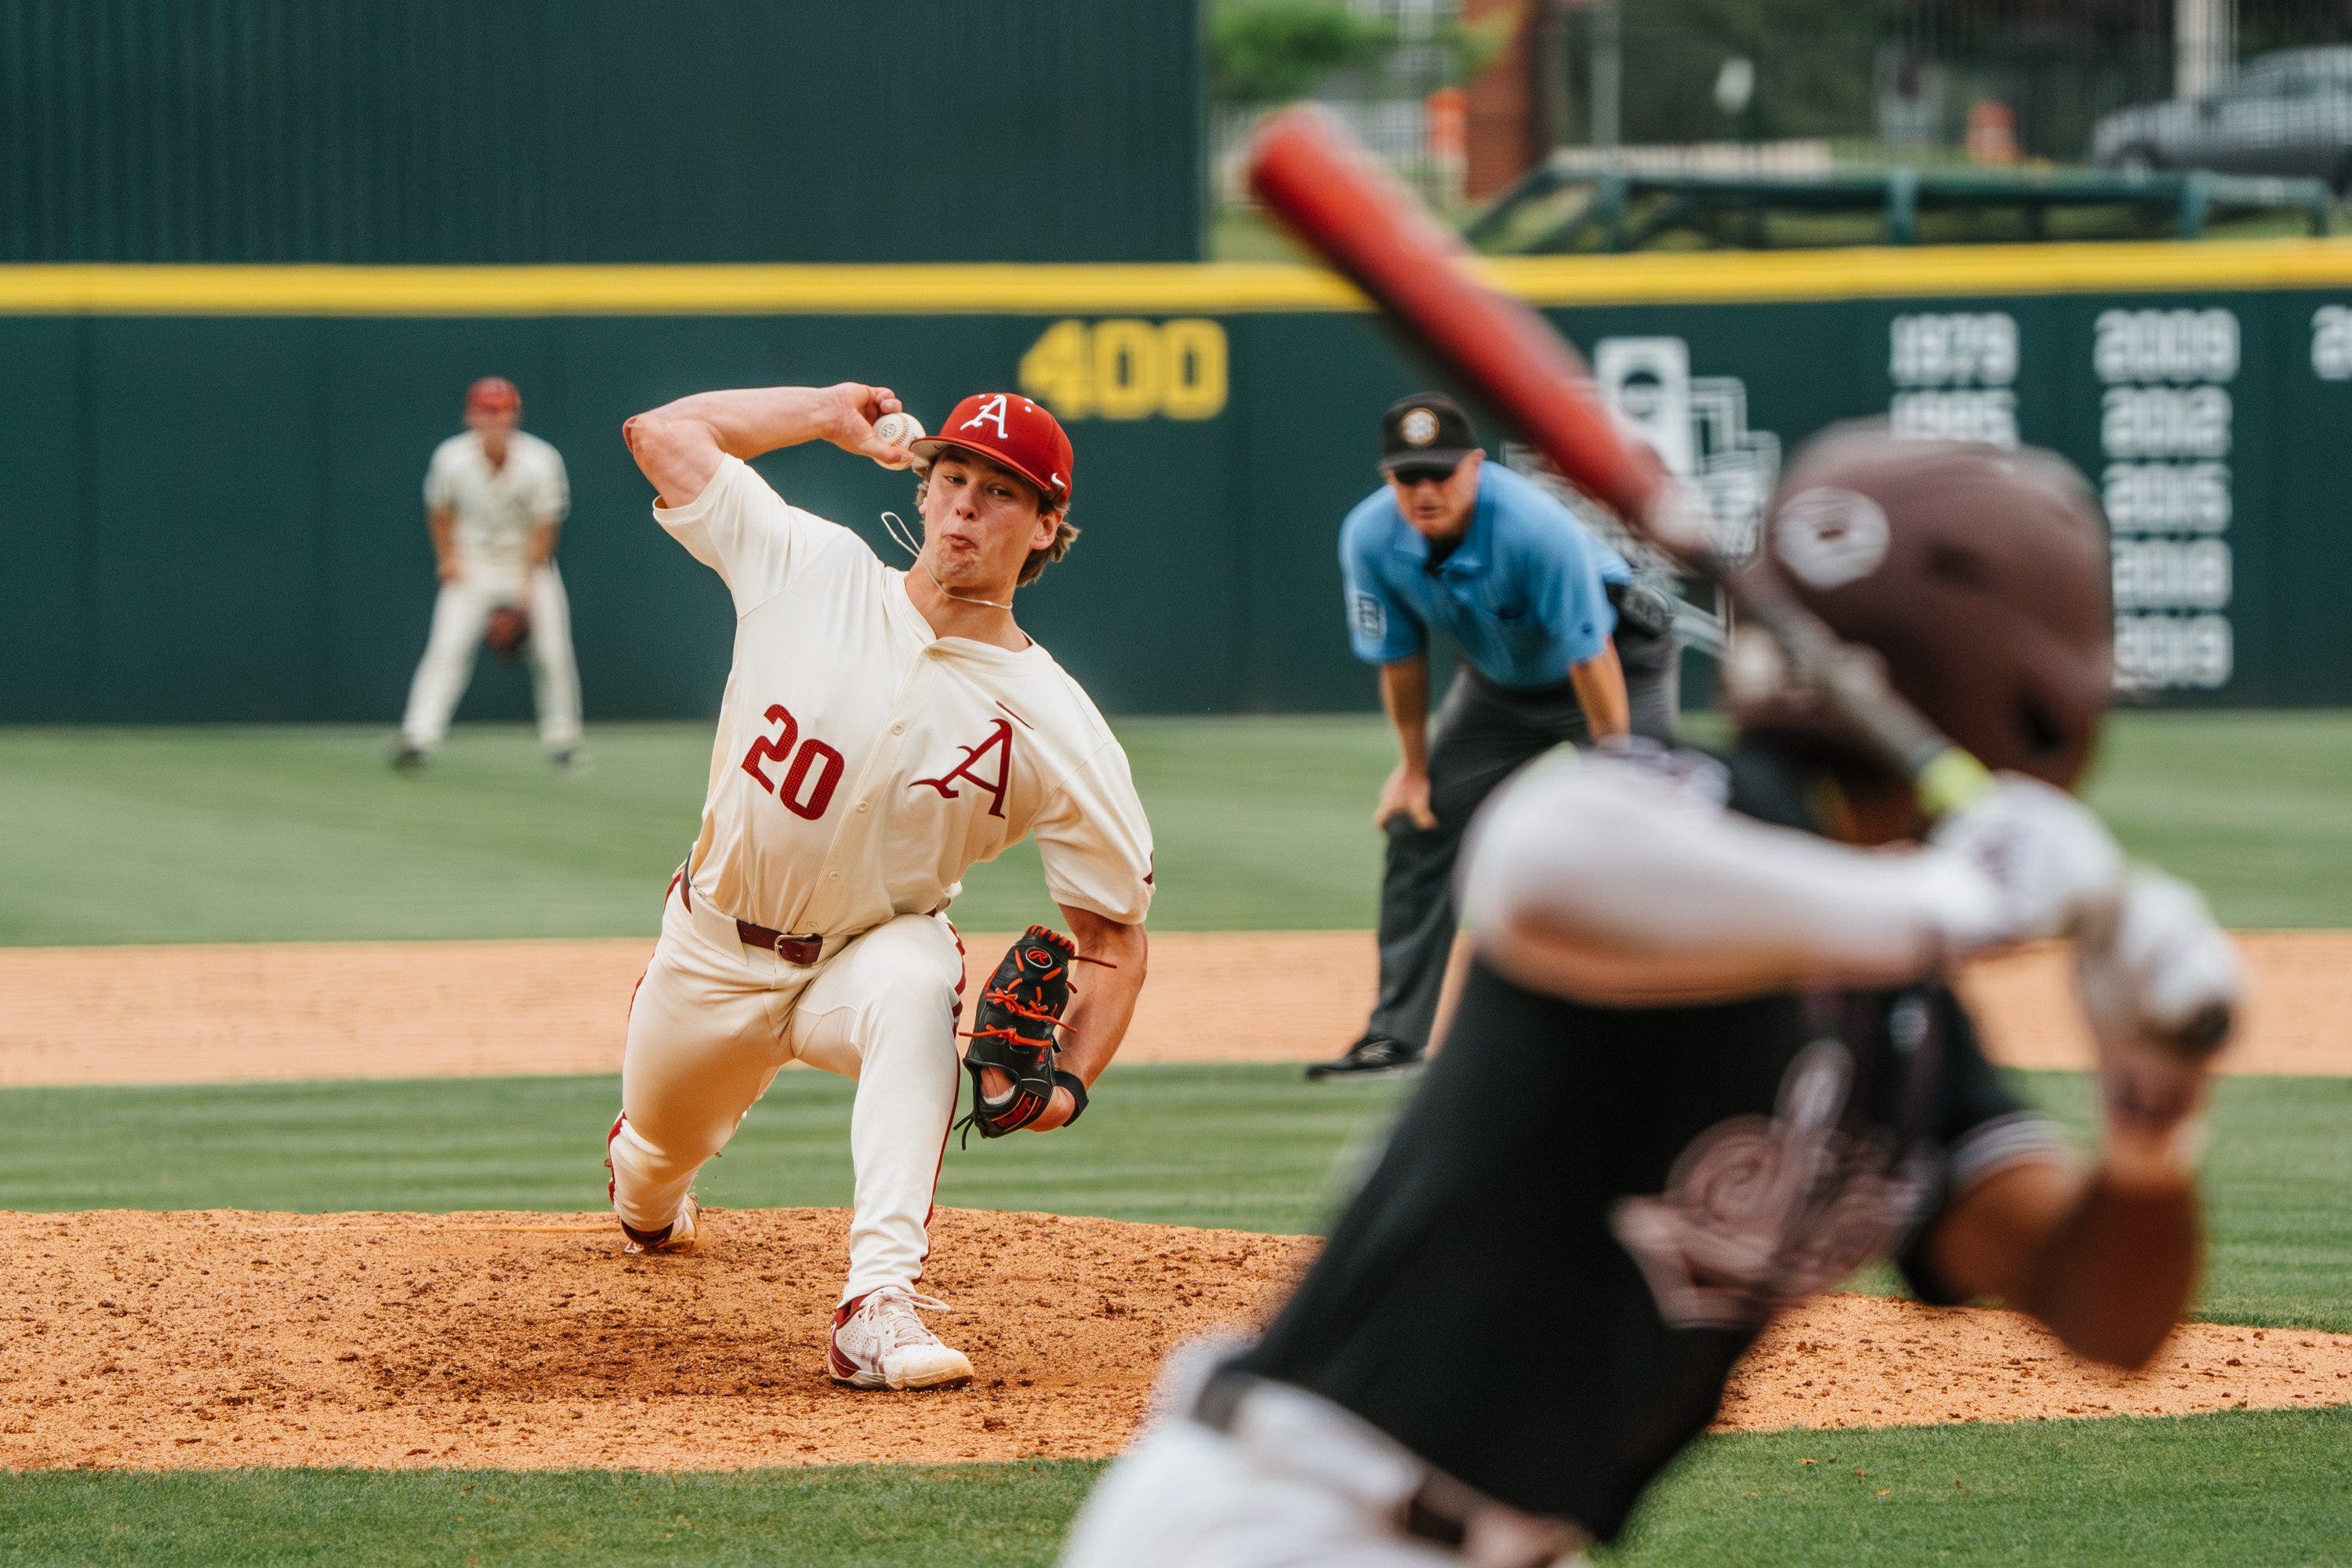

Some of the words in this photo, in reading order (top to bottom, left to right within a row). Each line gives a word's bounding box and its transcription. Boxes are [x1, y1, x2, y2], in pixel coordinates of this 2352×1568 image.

[1018, 318, 1227, 420] 400
[1889, 314, 2019, 385] 1979
[960, 394, 1008, 439] A
[741, 704, 844, 821] 20
[908, 718, 1013, 819] A
